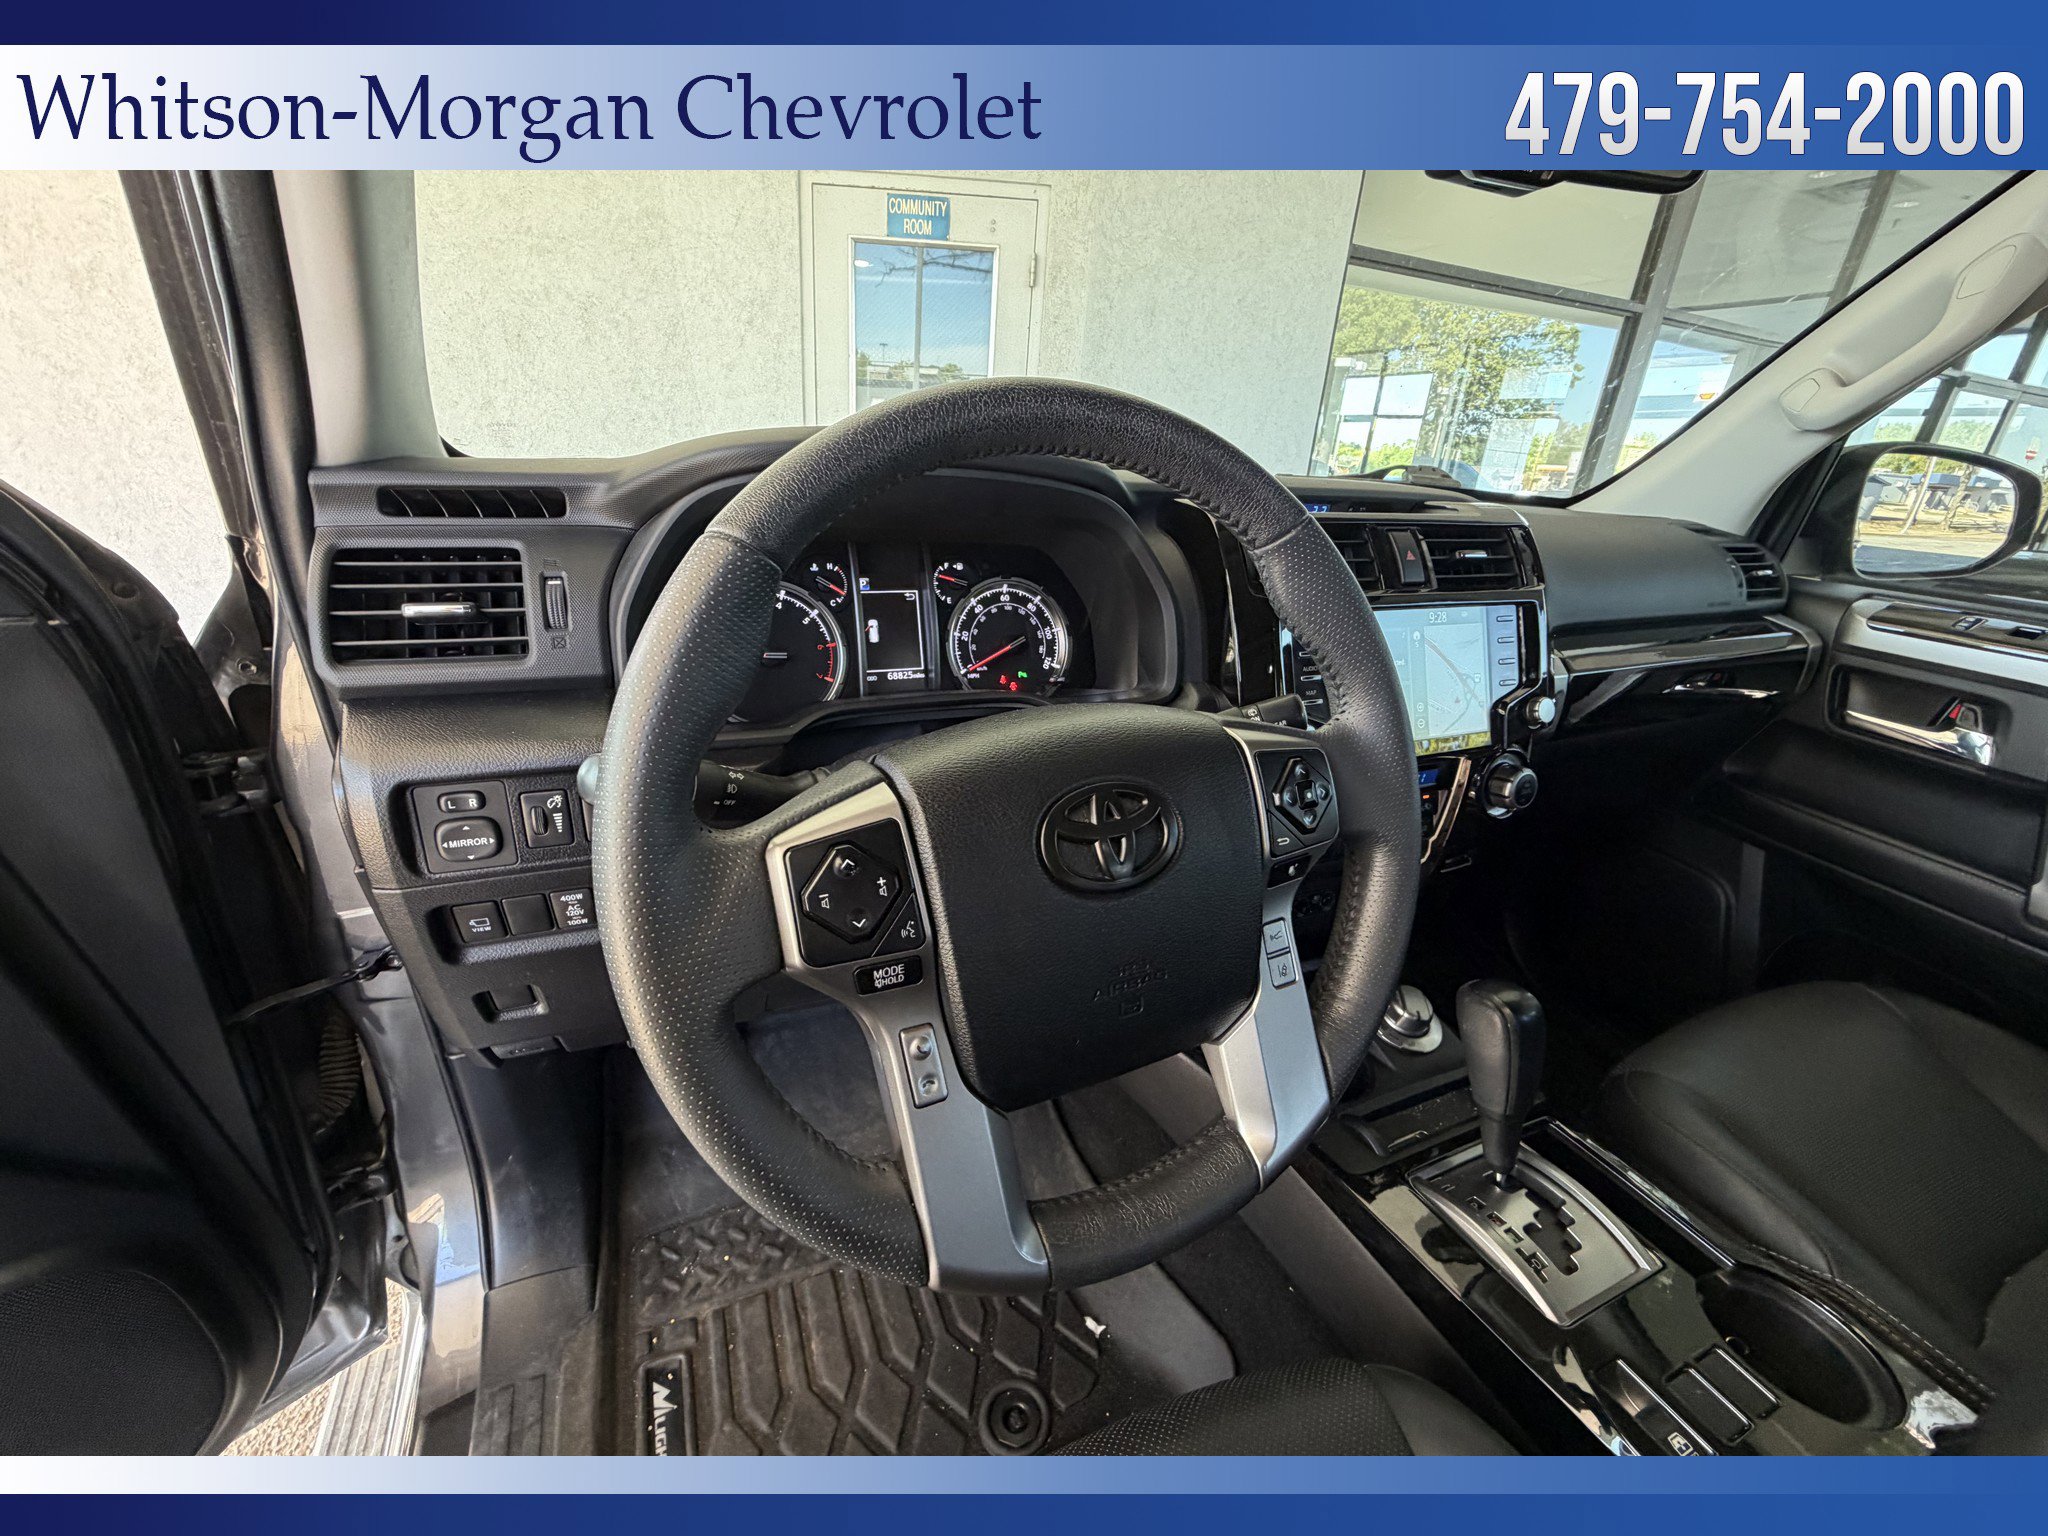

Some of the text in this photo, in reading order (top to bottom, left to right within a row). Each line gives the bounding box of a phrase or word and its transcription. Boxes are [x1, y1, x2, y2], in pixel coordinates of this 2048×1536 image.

[888, 197, 948, 217] COMMUNITY
[903, 218, 932, 235] ROOM
[1000, 594, 1010, 602] 60
[775, 602, 783, 610] 4
[974, 604, 984, 614] 40
[1026, 602, 1037, 612] 80
[802, 616, 810, 626] 5
[1429, 611, 1447, 623] 9:28
[961, 630, 969, 641] 20
[1044, 626, 1053, 640] 100
[1042, 657, 1052, 670] 120
[887, 671, 912, 680] 68825
[447, 801, 456, 809] L
[449, 838, 488, 848] MIRROR
[560, 893, 583, 902] 400W
[566, 909, 585, 918] 120V
[873, 964, 905, 979] MODE
[882, 974, 904, 985] HOLD
